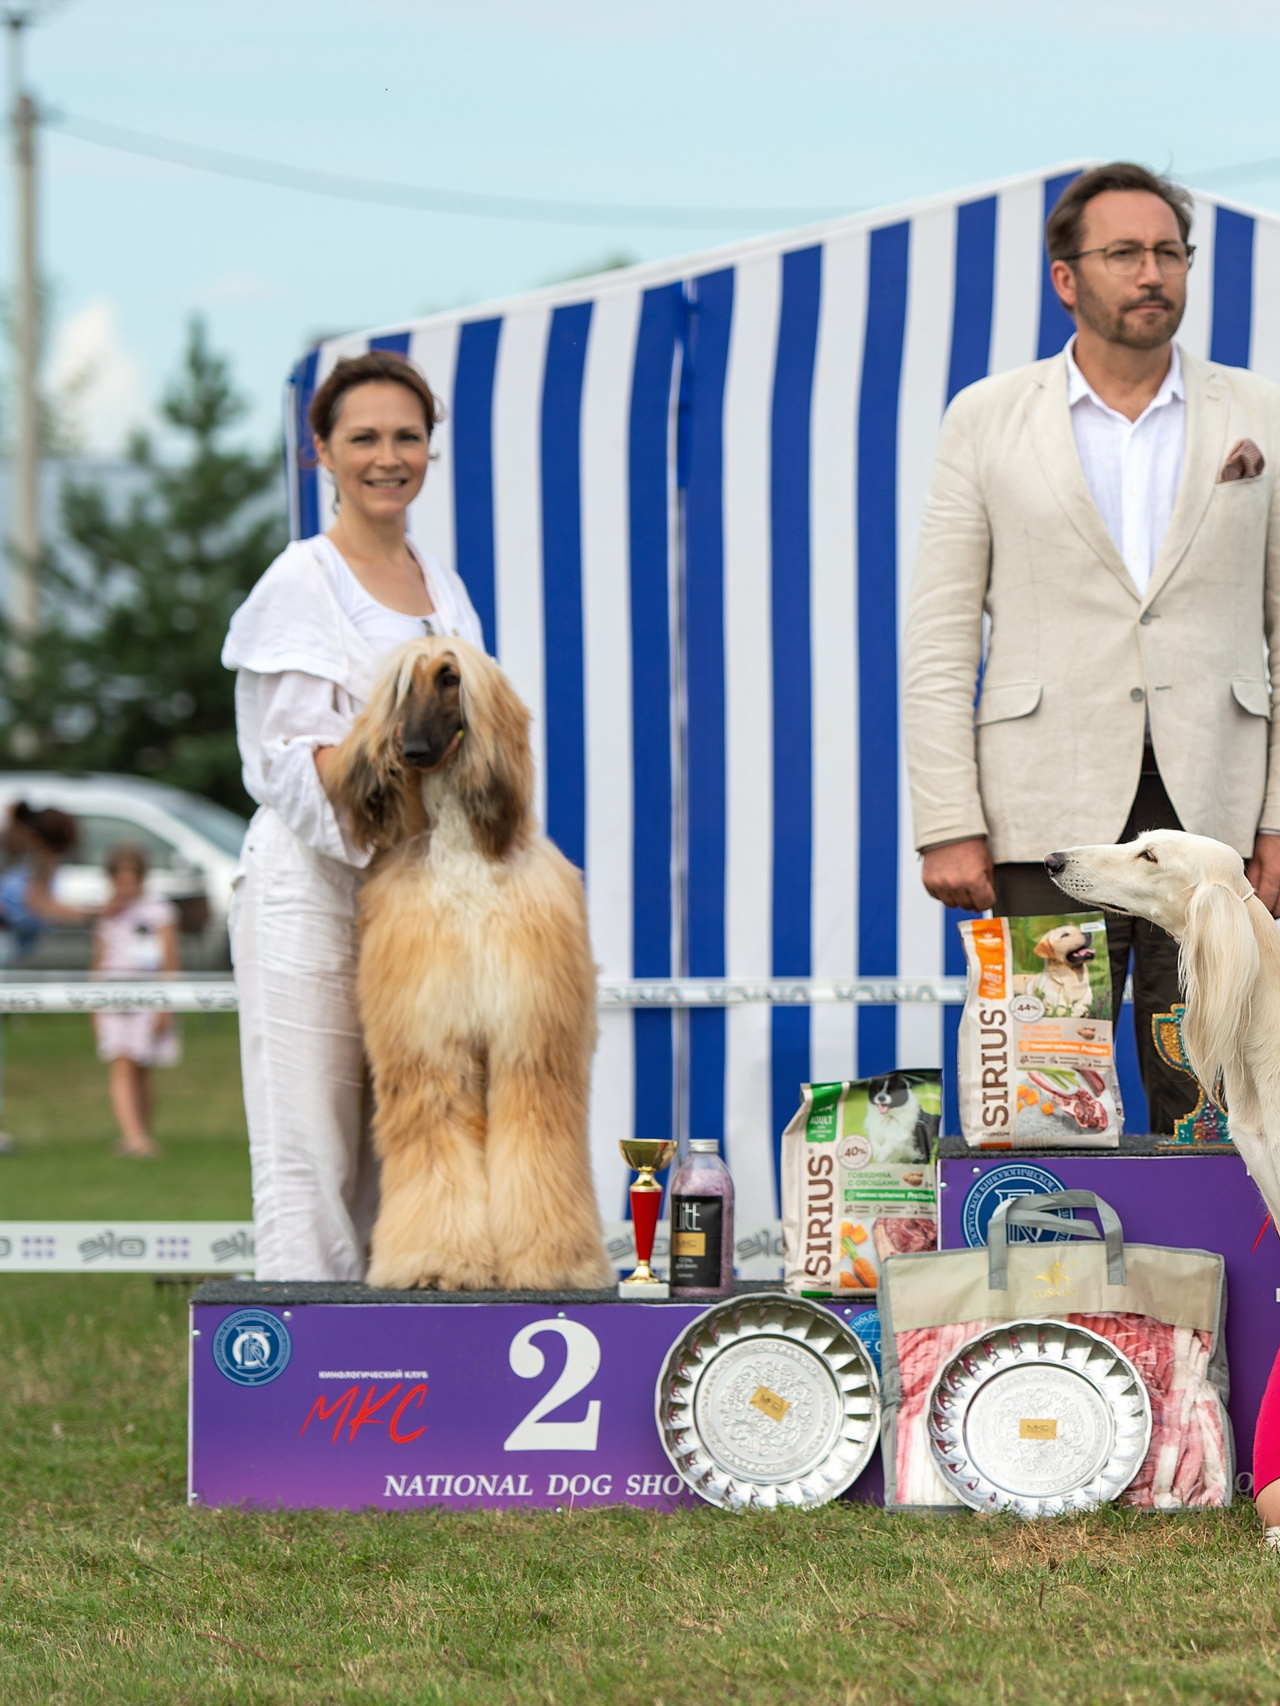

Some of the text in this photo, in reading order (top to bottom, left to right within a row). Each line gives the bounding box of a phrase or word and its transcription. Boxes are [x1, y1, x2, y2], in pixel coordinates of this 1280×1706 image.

[979, 1009, 1010, 1127] SIRIUS
[804, 1155, 833, 1276] SIRIUS
[318, 1368, 429, 1379] КИНОЛОГИЧЕСКИЙ КЛУБ
[503, 1318, 601, 1451] 2
[383, 1474, 695, 1497] NATIONAL DOG SHO
